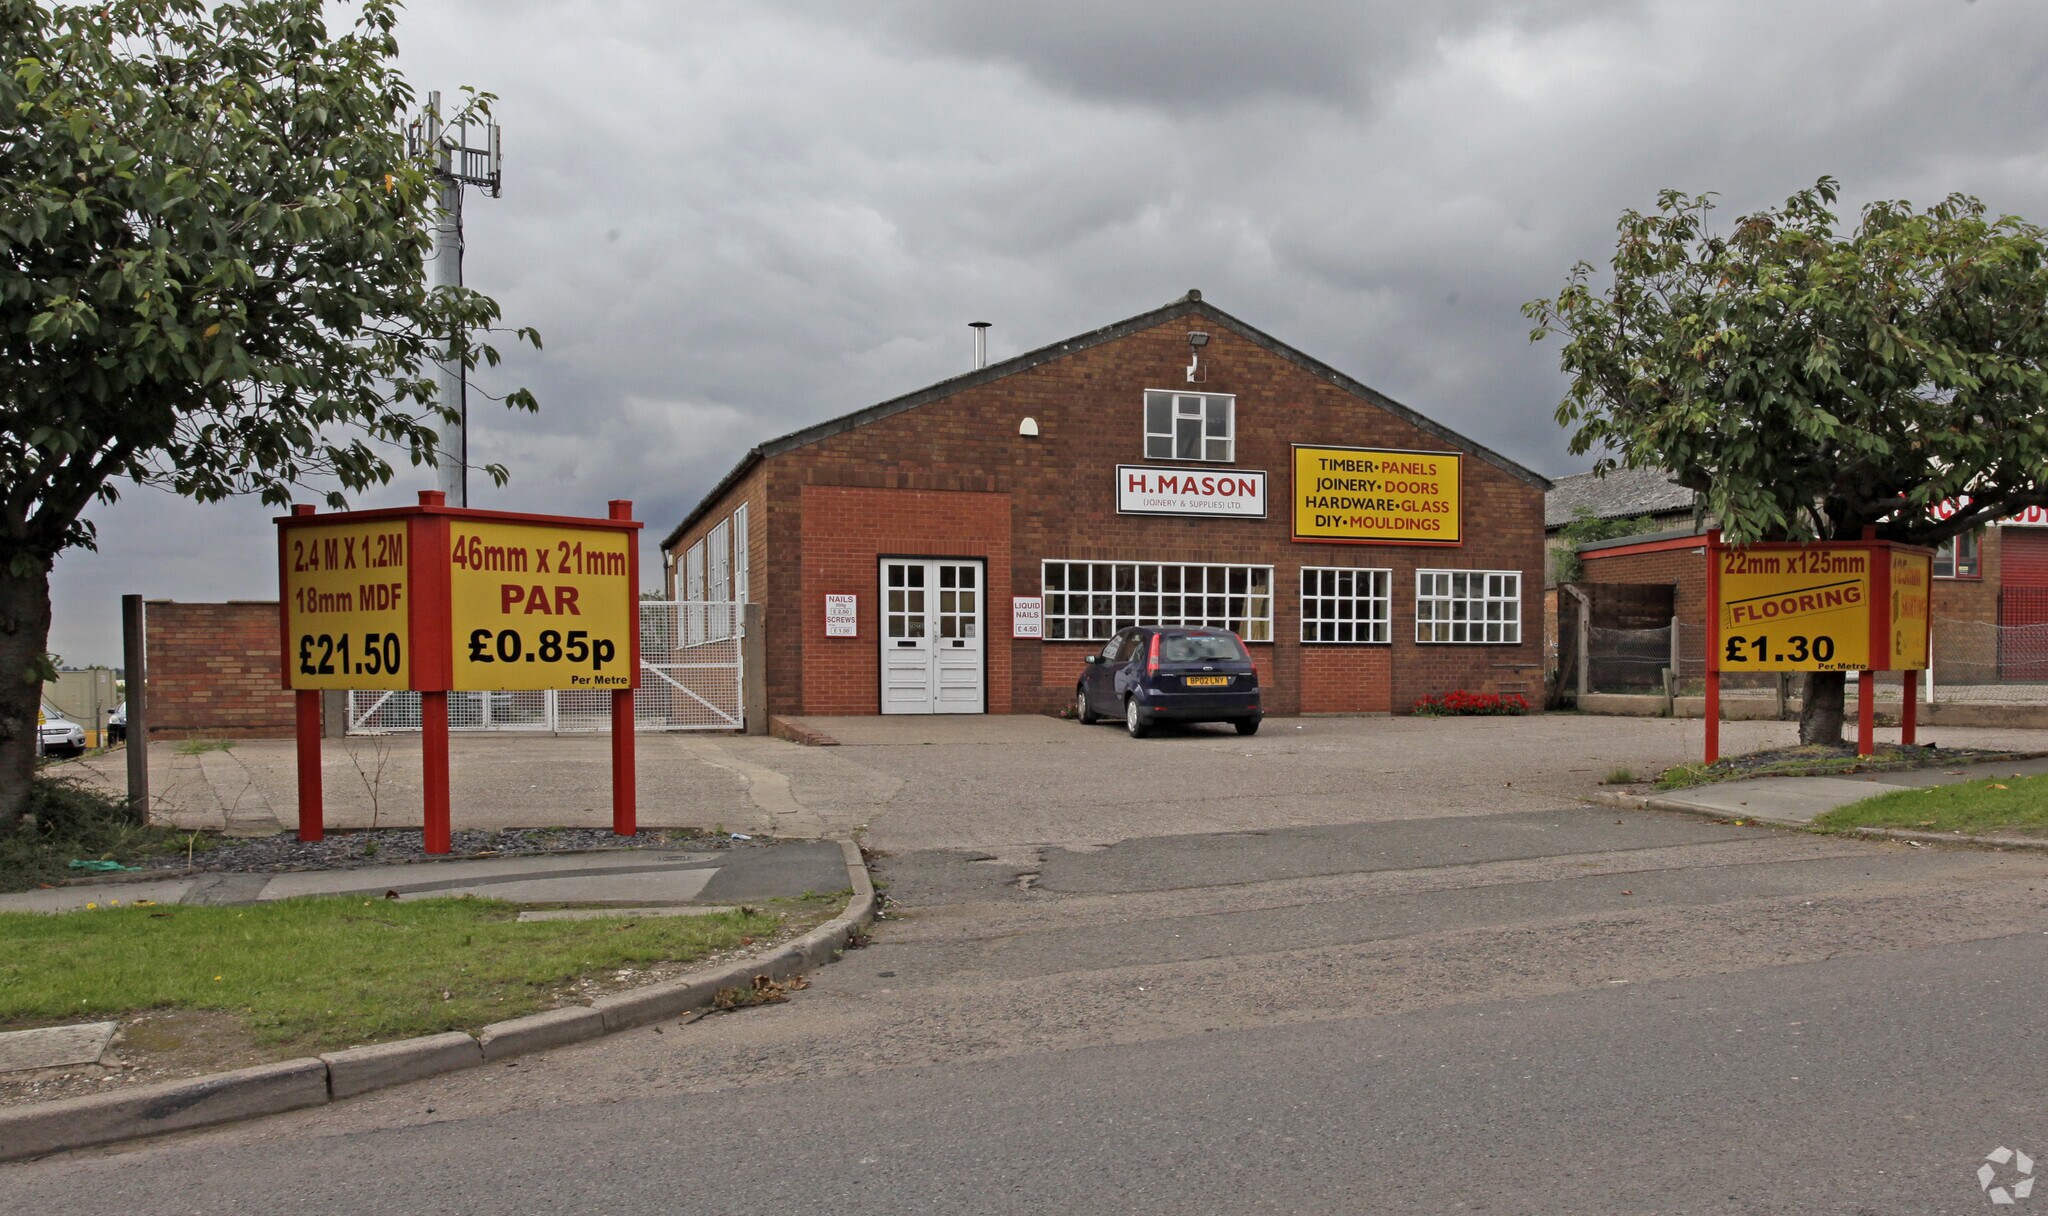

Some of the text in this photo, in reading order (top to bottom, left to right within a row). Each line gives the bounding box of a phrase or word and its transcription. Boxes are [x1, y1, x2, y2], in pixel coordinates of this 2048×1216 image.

[294, 533, 403, 572] 2.4 M X 1.2M
[452, 534, 626, 576] 46mm x 21mm
[1724, 551, 1780, 574] 22mm
[295, 582, 402, 614] 18mm MDF
[501, 584, 581, 616] PAR
[828, 595, 854, 603] NAILS
[1732, 586, 1861, 623] FLOORING
[826, 616, 856, 624] SCREWS
[1016, 611, 1039, 619] NAILS
[299, 632, 401, 676] £21.50
[467, 628, 616, 671] £0.85p
[1725, 635, 1835, 662] £1.30
[571, 675, 628, 685] Per Metre
[1818, 662, 1866, 670] Per Metre
